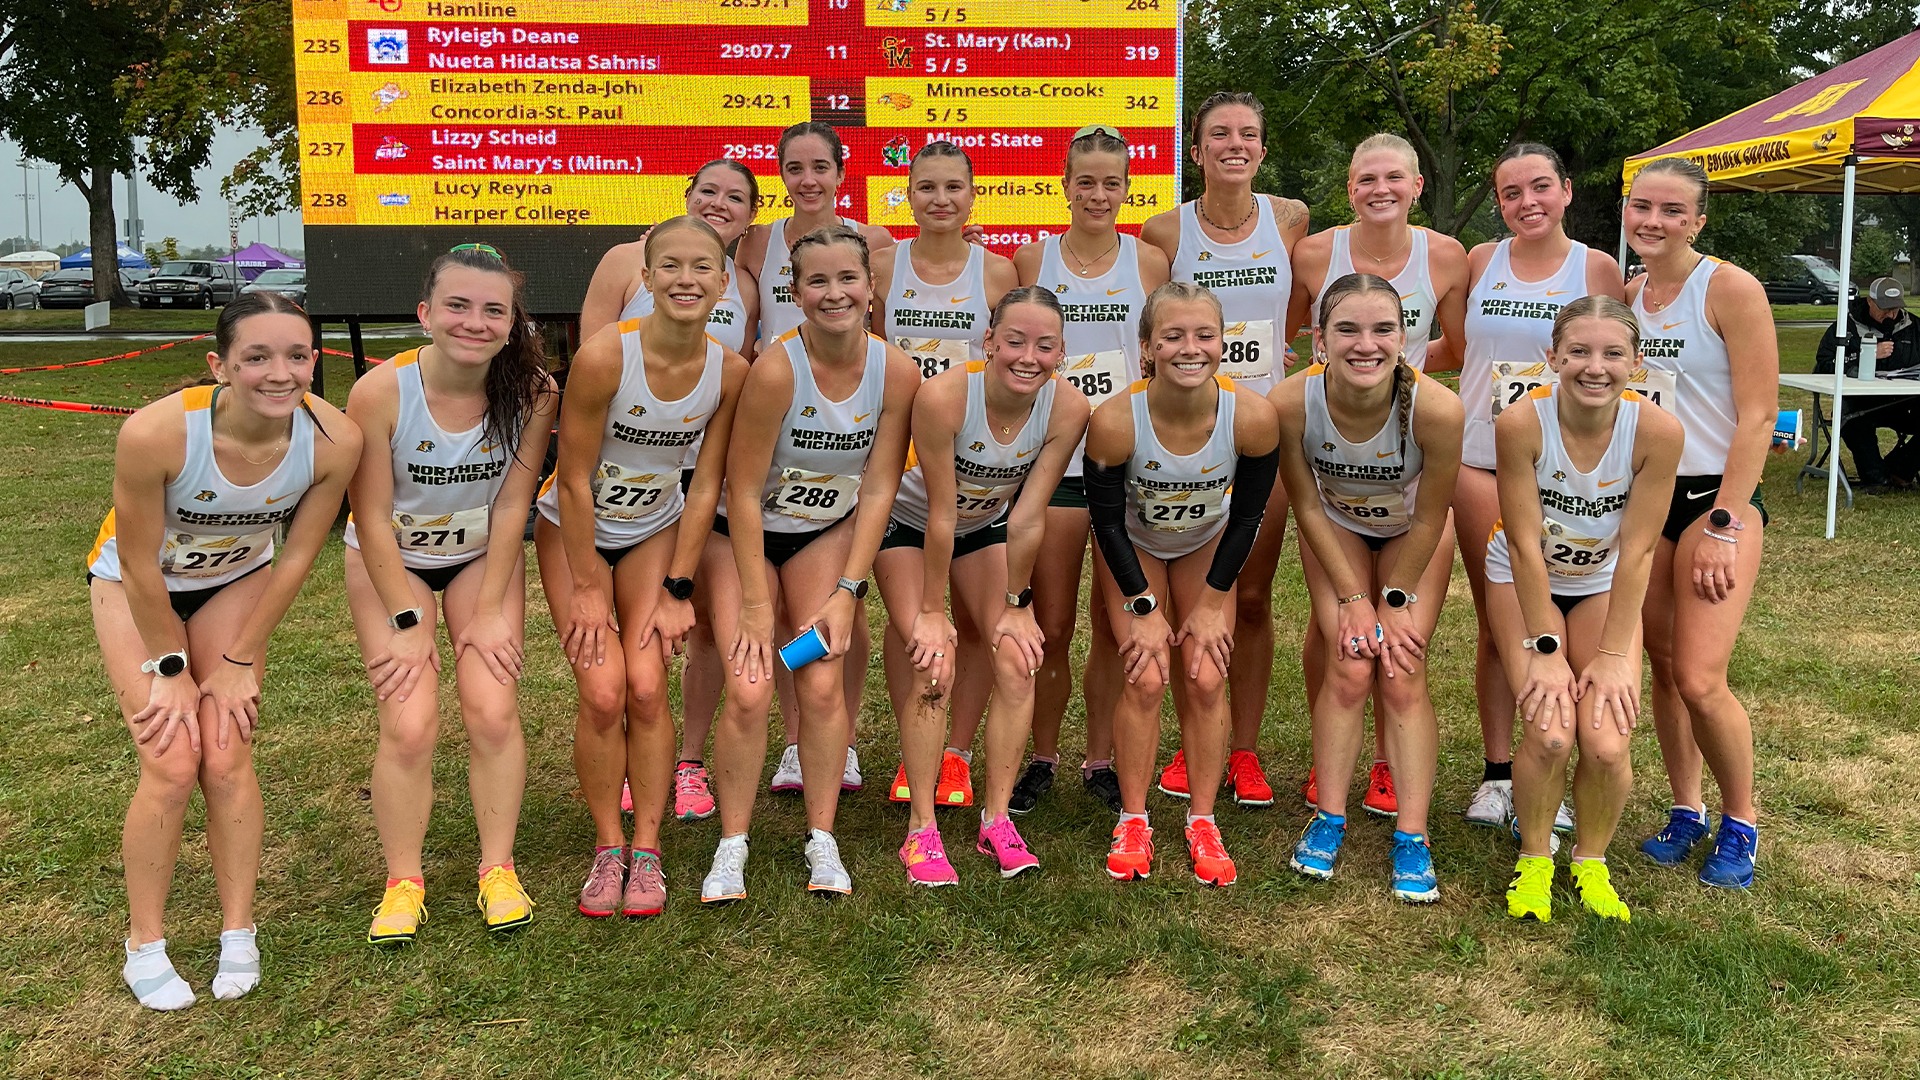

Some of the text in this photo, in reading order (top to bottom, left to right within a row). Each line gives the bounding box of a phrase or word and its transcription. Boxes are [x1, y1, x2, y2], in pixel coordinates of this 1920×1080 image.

[427, 1, 517, 17] Hamline
[1126, 0, 1160, 10] 264
[925, 8, 936, 22] 5
[956, 8, 967, 22] 5
[427, 27, 579, 47] Ryleigh Deane
[925, 33, 1071, 52] St. Mary (Kan.)
[303, 39, 341, 54] 235
[720, 44, 793, 59] 29:07.7
[826, 45, 848, 60] 11
[1125, 46, 1160, 60] 319
[428, 54, 660, 70] Nueta Hidatsa Sahnis
[925, 58, 937, 73] 5
[956, 58, 968, 73] 5
[430, 79, 643, 98] Elizabeth Zenda-Joh
[306, 91, 344, 105] 236
[722, 94, 791, 109] 29:42.1
[827, 94, 851, 110] 12
[1126, 95, 1159, 109] 342
[431, 104, 623, 119] Concordia-St. Paul
[926, 108, 937, 122] 5
[957, 108, 968, 122] 5
[431, 129, 557, 149] Lizzy Scheid
[926, 132, 1043, 147] Minot State
[308, 142, 346, 157] 237
[722, 144, 778, 159] 29:52
[1707, 149, 1742, 173] GOLDEN
[1743, 140, 1791, 166] GOPHERS
[432, 155, 643, 174] Saint Mary's (Minn.)
[433, 181, 553, 199] Lucy Reyna
[311, 193, 347, 207] 238
[1125, 194, 1158, 207] 434
[434, 205, 591, 224] Harper College
[1193, 266, 1278, 281] NORTHERN
[1198, 275, 1275, 288] MICHIGAN
[894, 309, 975, 321] NORTHERN
[1060, 304, 1130, 313] ORTHERN
[896, 318, 972, 330] MICHIGAN
[1065, 313, 1127, 322] ICHIGAN
[611, 420, 703, 440] NORTHERN
[790, 427, 875, 442] NORTHERN
[792, 438, 871, 451] MICHIGAN
[407, 459, 506, 477] NORTHERN
[1314, 456, 1405, 475] NORTHERN
[412, 470, 501, 486] MICHIGAN
[1318, 466, 1401, 481] MICHIGAN
[1136, 475, 1229, 490] NORTHERN
[604, 485, 662, 507] 273
[784, 485, 840, 508] 288
[1540, 488, 1628, 510] NORTHERN
[176, 504, 295, 522] NORTHERN
[1152, 504, 1206, 521] 279
[1337, 501, 1389, 518] 269
[1543, 498, 1625, 518] MICHIGAN
[410, 528, 466, 546] 271
[182, 546, 252, 570] 272
[1551, 543, 1610, 566] 283
